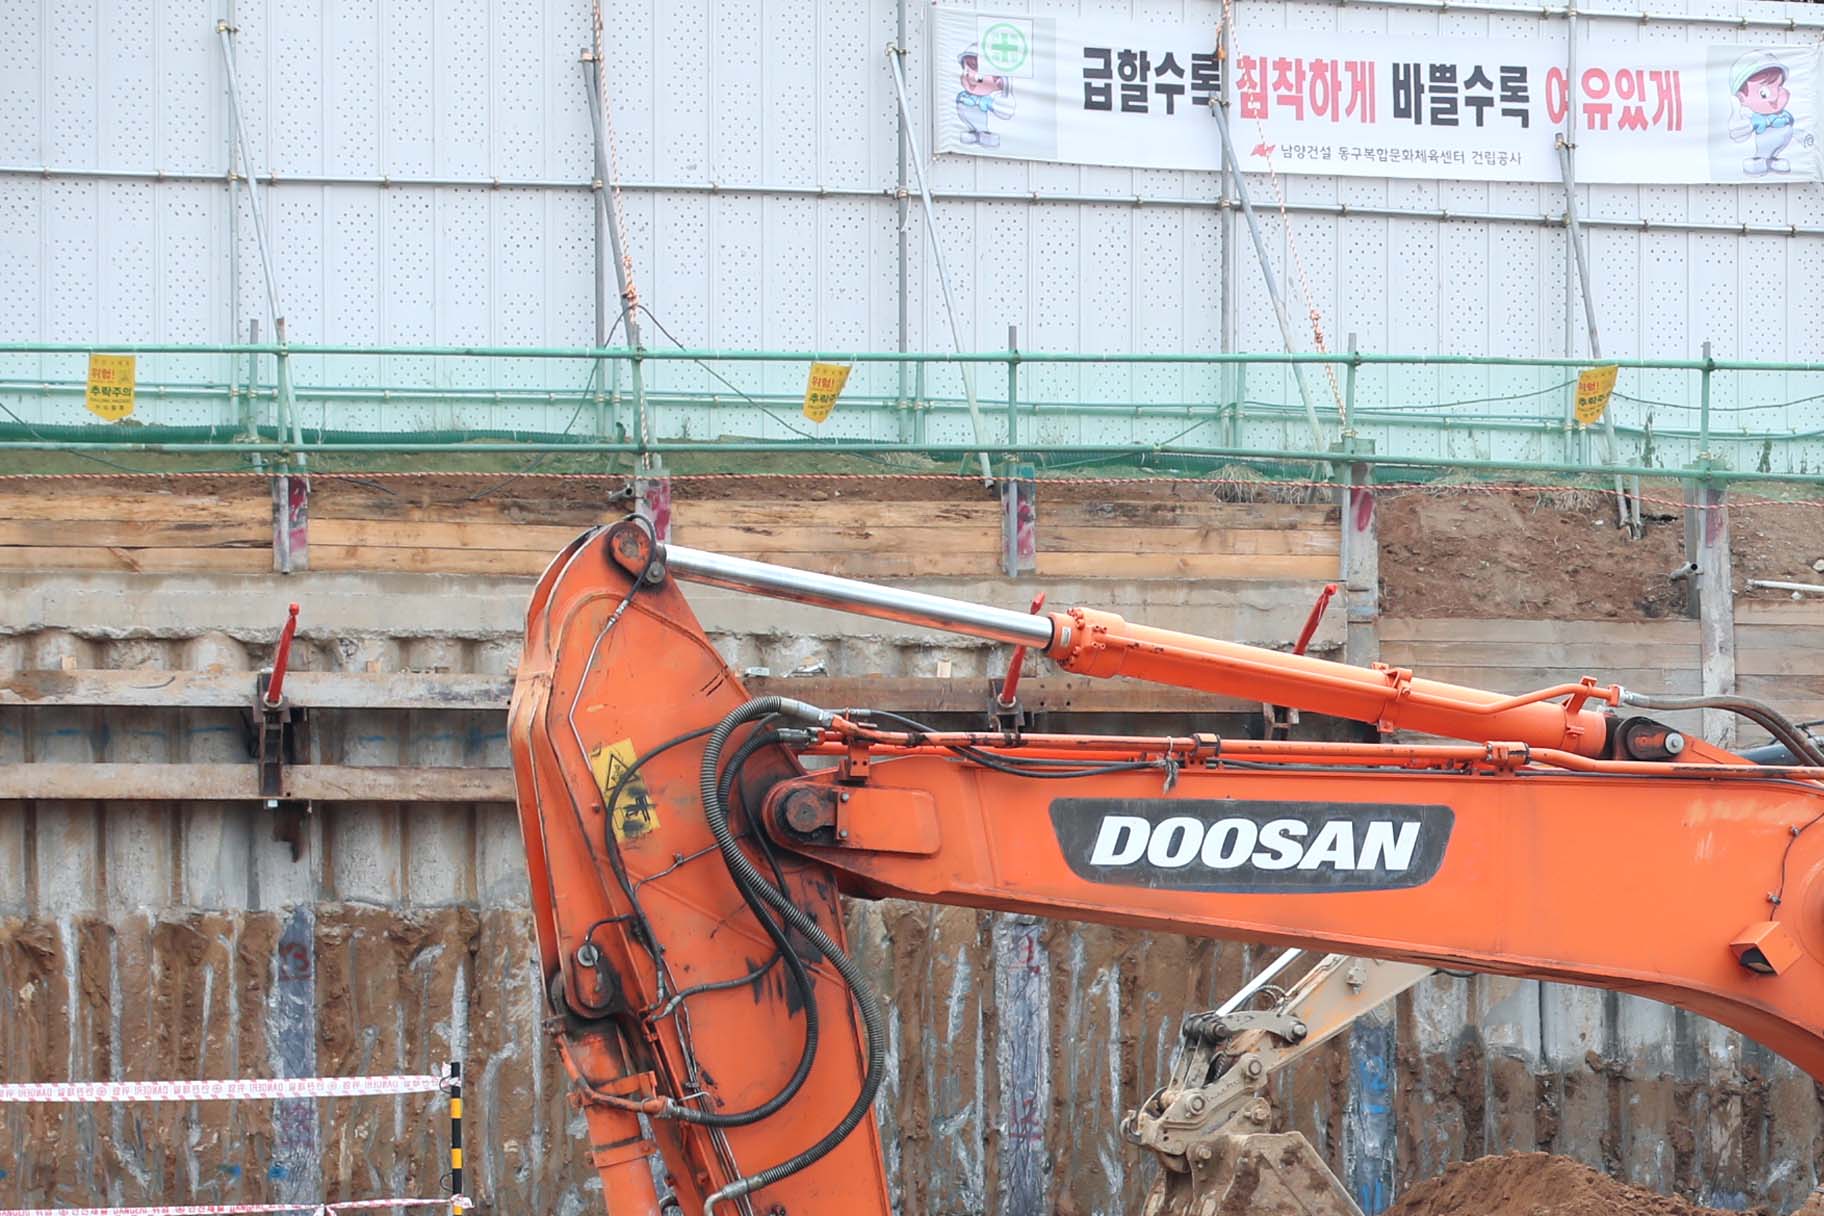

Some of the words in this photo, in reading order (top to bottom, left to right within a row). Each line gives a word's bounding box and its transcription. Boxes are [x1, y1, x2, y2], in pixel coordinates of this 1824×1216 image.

[1083, 46, 1222, 115] 급할수록
[1236, 55, 1376, 124] 침착하게
[1392, 62, 1530, 128] 바쁠수록
[1545, 66, 1683, 131] 여유있게
[1280, 144, 1331, 160] 남양건설
[1338, 146, 1464, 165] 동구복합문화체육센터
[1472, 150, 1521, 166] 건립공사
[90, 386, 131, 397] 추락주의
[1089, 815, 1421, 870] DOOSAN
